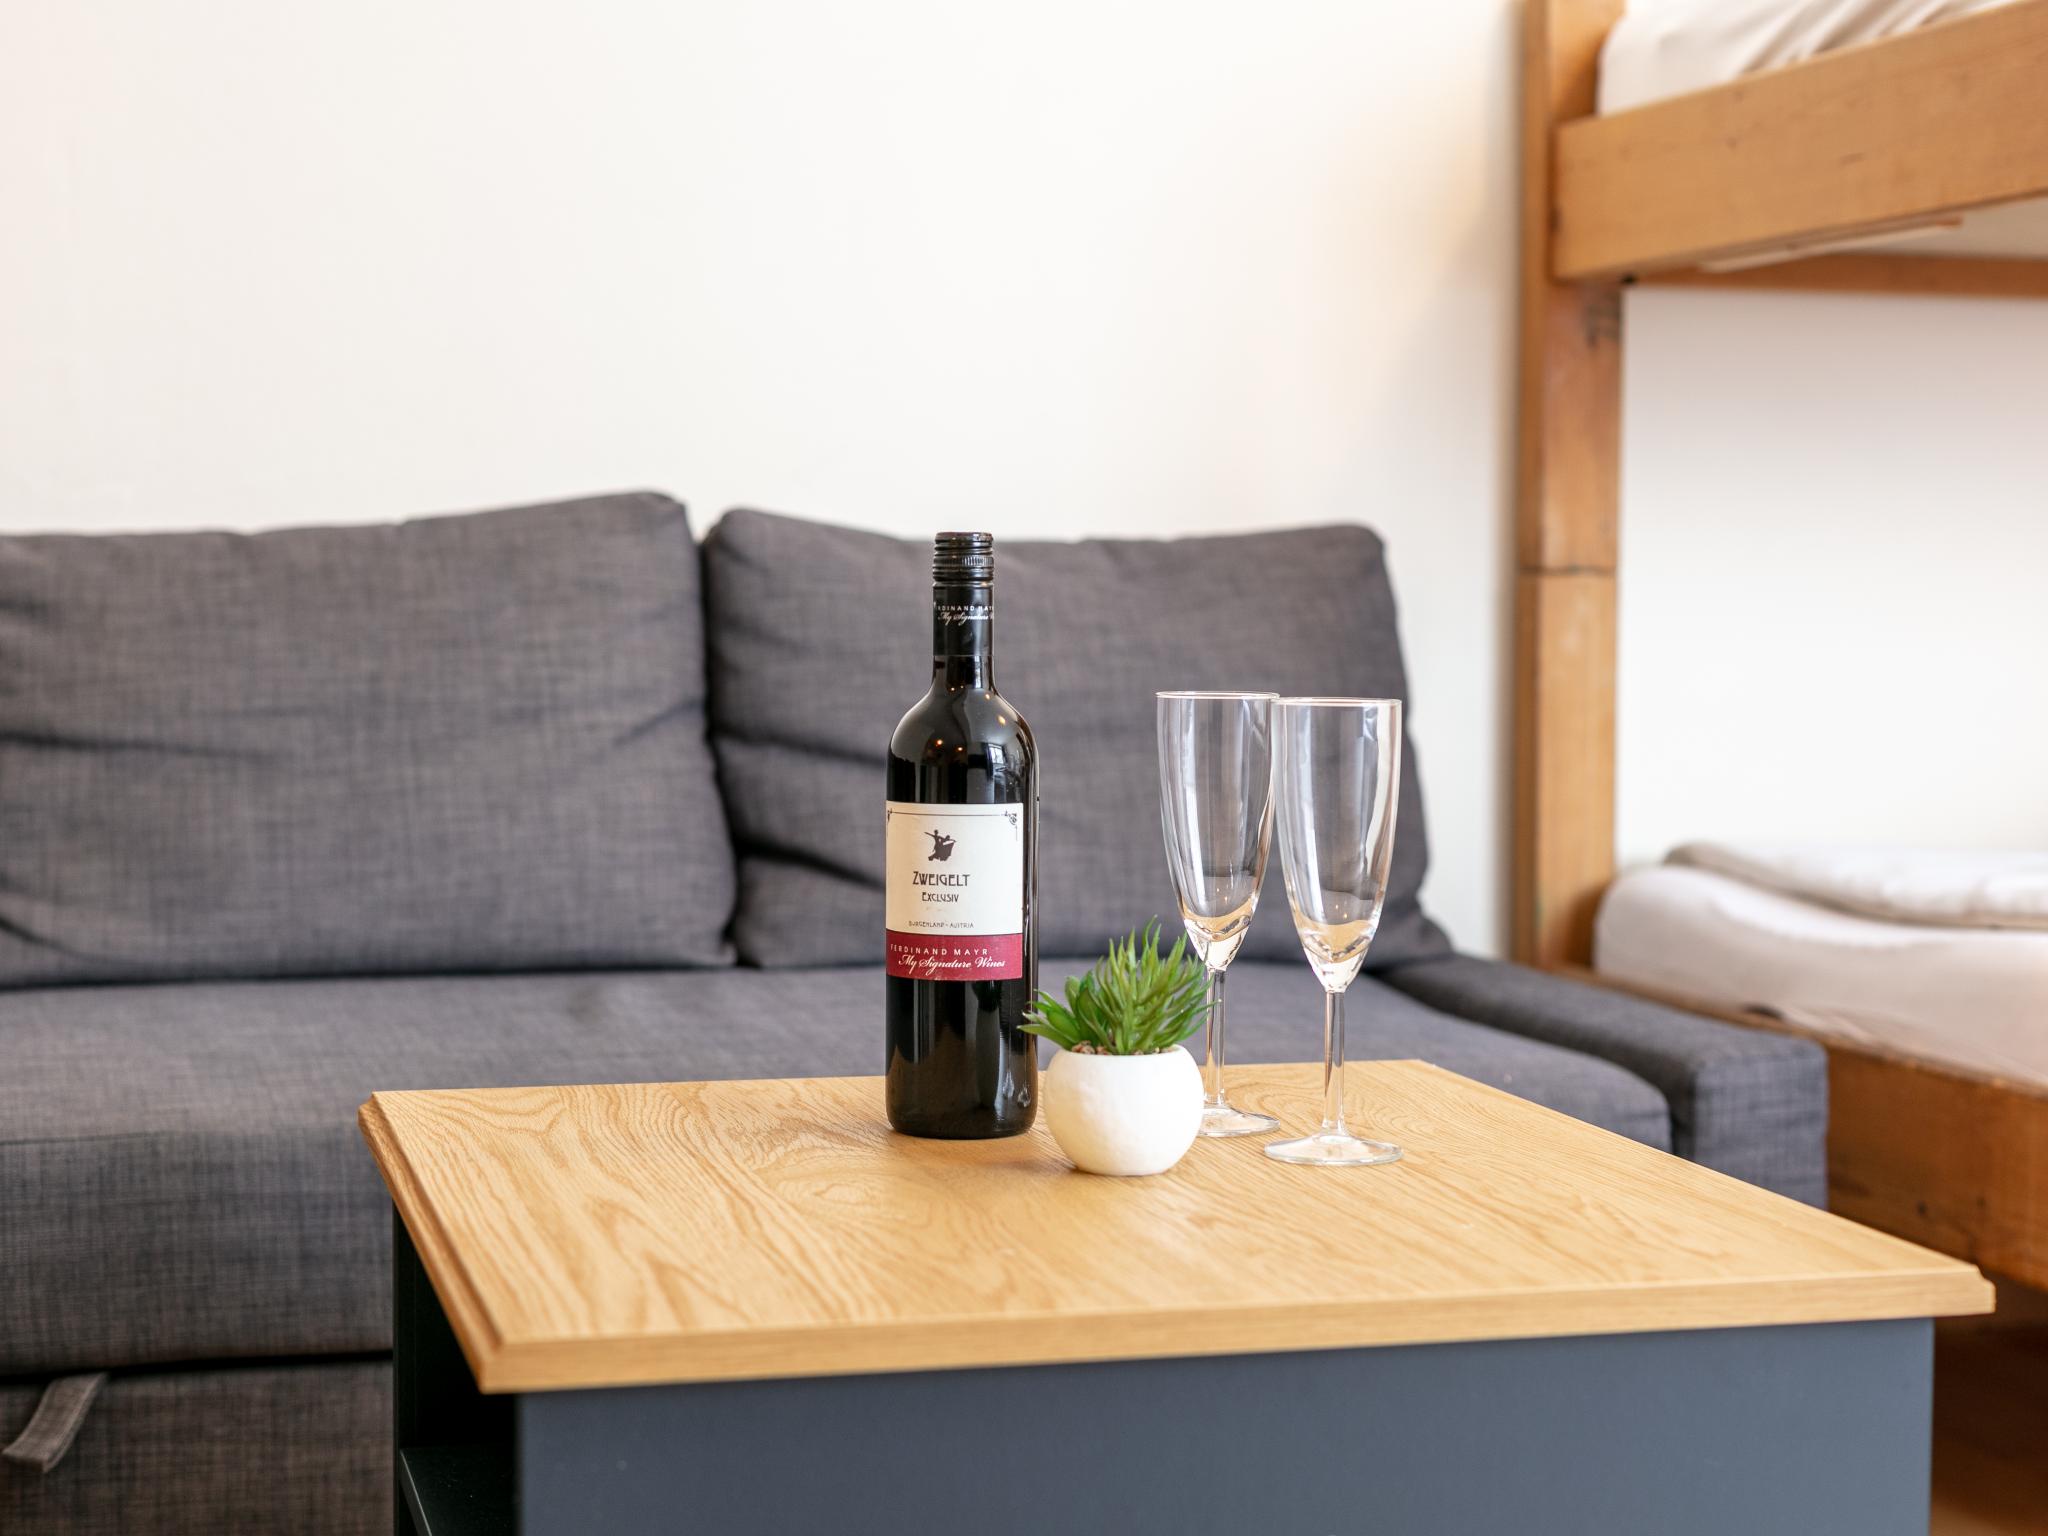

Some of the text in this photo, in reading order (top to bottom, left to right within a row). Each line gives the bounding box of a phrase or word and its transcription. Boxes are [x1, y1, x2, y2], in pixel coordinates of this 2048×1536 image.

[912, 871, 970, 887] ZWEIGELT
[921, 891, 960, 903] EXCLUSIV
[890, 943, 988, 956] FERDINAND MAYR
[898, 954, 1006, 976] My Signature Wines
